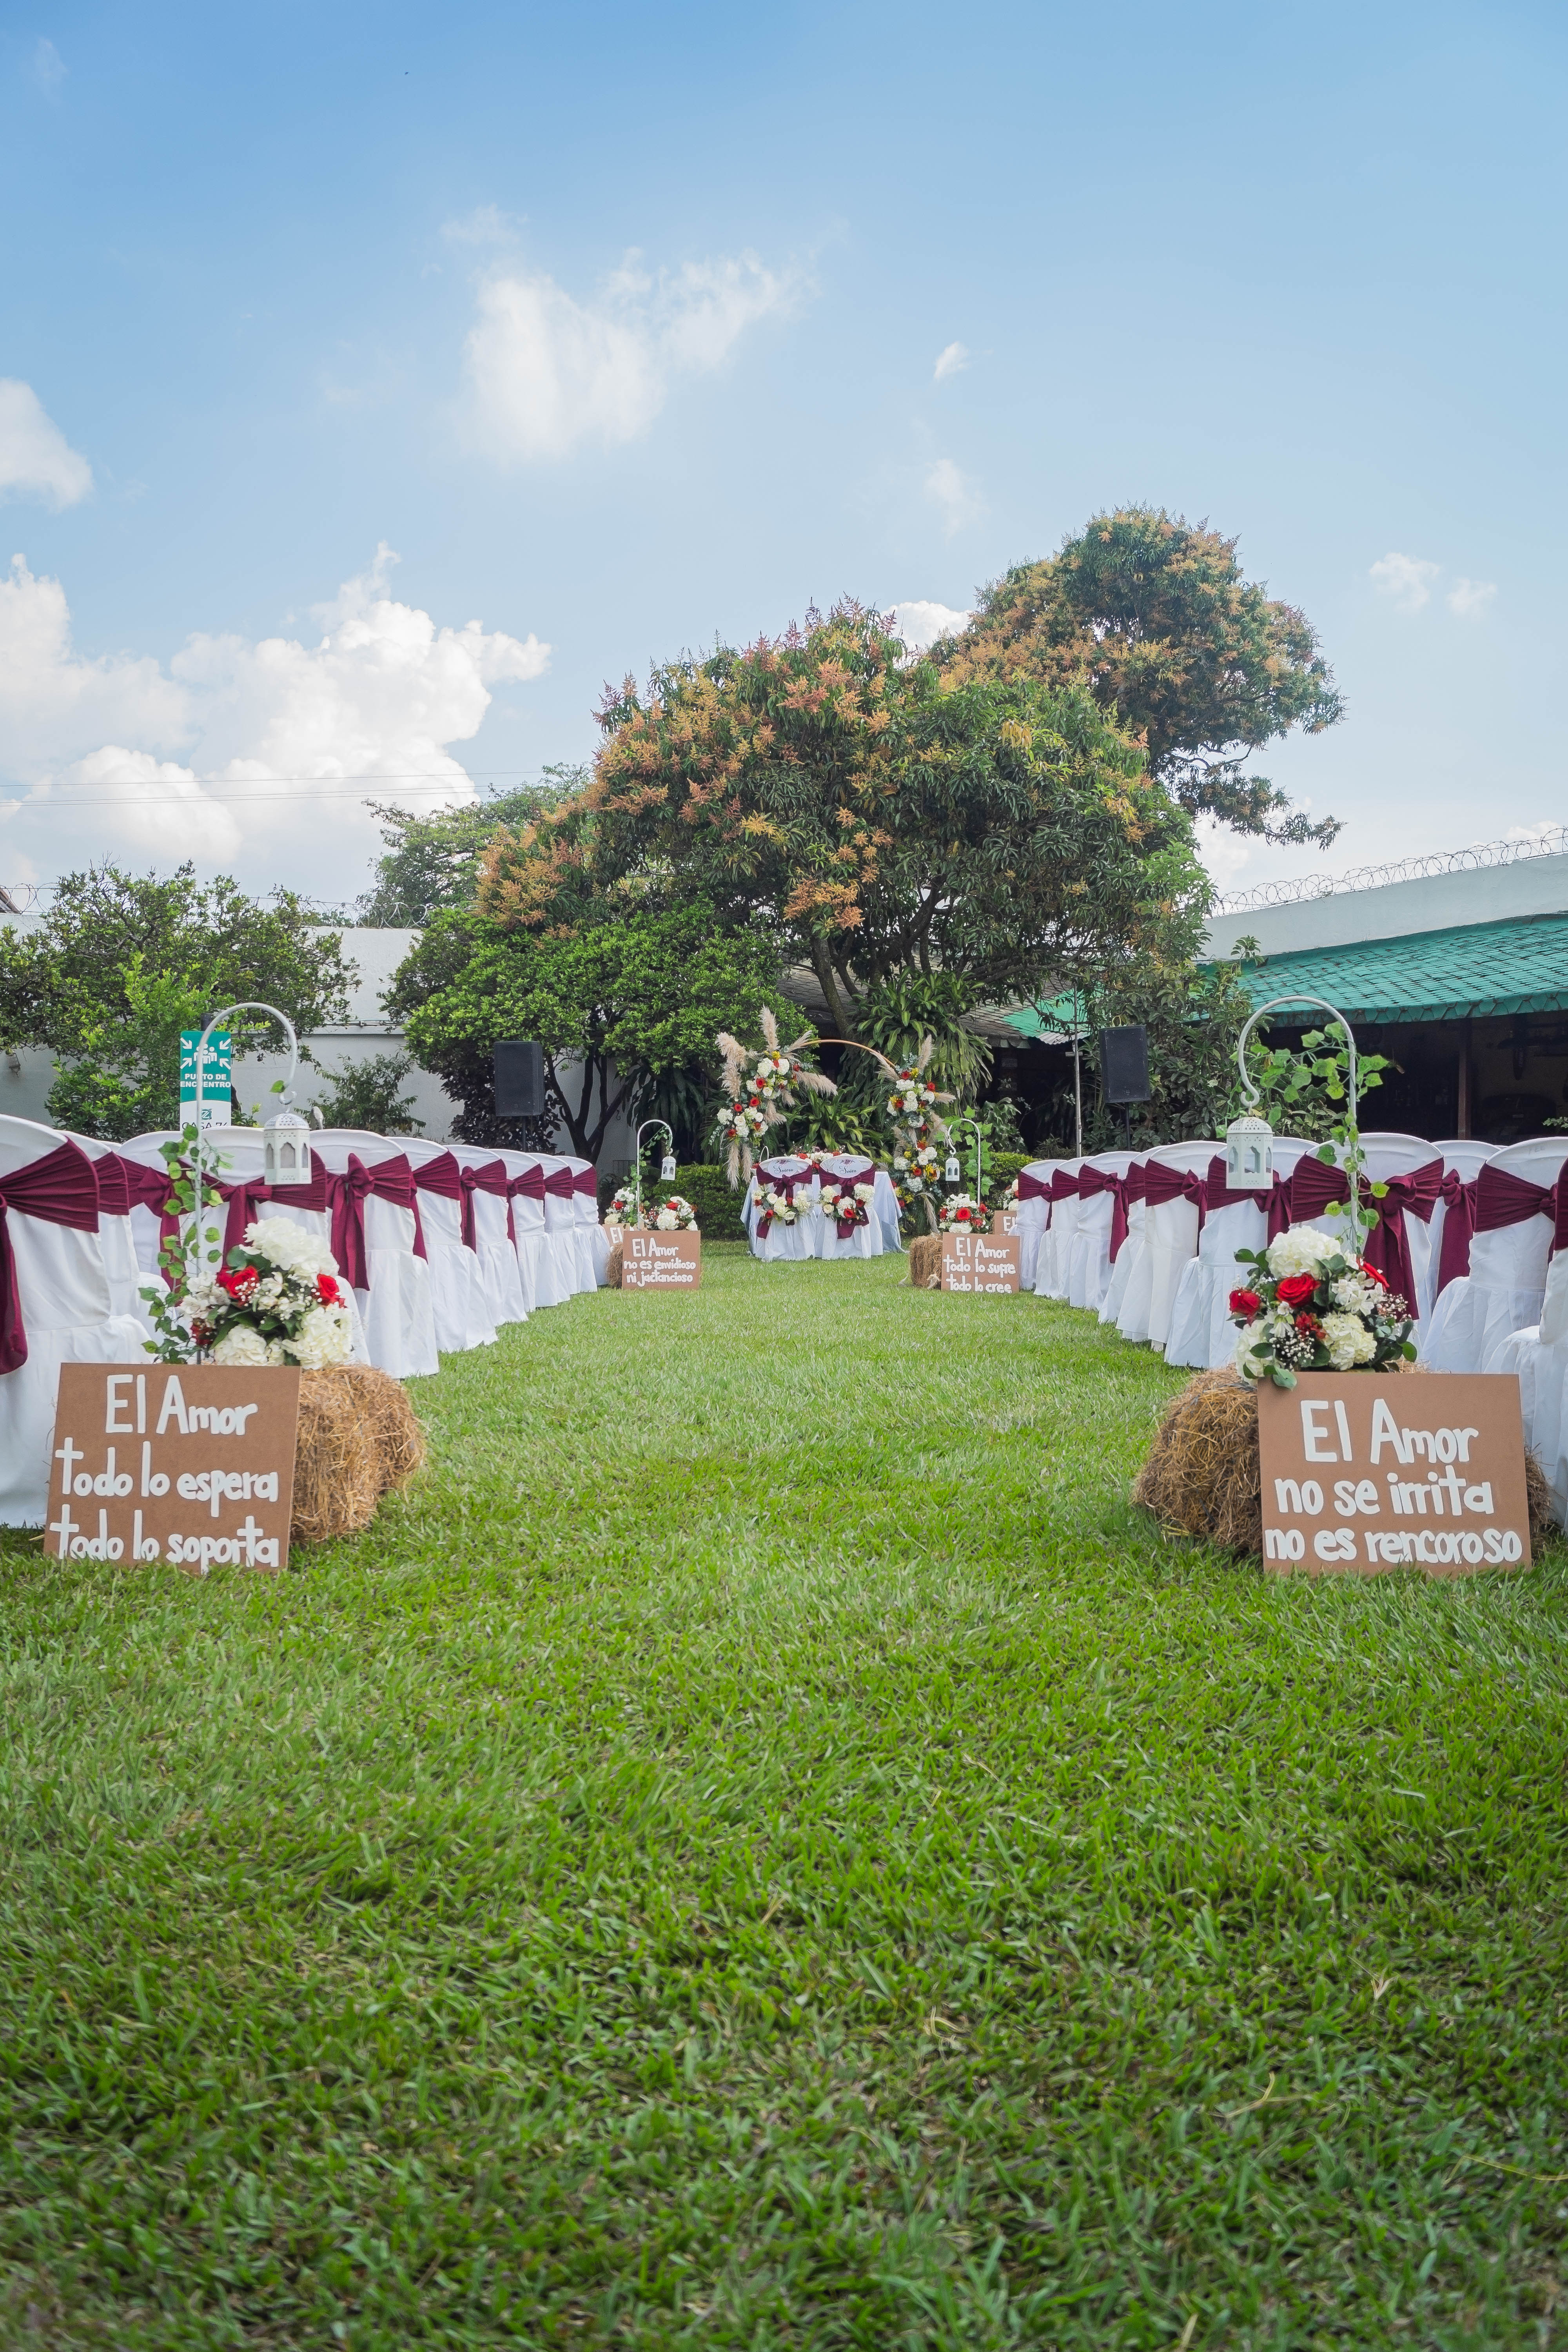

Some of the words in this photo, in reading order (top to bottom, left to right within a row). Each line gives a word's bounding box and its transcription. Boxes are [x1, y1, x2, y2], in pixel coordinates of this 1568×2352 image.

[773, 1165, 794, 1174] Señora
[839, 1165, 857, 1174] Señor
[1004, 1216, 1015, 1231] El
[610, 1227, 623, 1243] El
[632, 1238, 646, 1257] El
[648, 1238, 679, 1257] Amor
[956, 1237, 971, 1257] El
[975, 1239, 1010, 1258] Amor
[624, 1261, 638, 1269] no
[639, 1260, 652, 1270] es
[654, 1257, 696, 1270] envidioso
[943, 1254, 971, 1272] todo
[975, 1258, 985, 1272] lo
[626, 1272, 637, 1283] ni
[637, 1269, 693, 1287] jactancioso
[946, 1274, 972, 1291] todo
[975, 1276, 984, 1292] lo
[985, 1283, 1012, 1294] cree
[106, 1374, 146, 1434] El
[156, 1375, 258, 1436] Amor
[1301, 1399, 1352, 1463] El
[1370, 1398, 1479, 1465] Amor
[55, 1437, 133, 1497] todo
[141, 1441, 170, 1497] lo
[176, 1470, 279, 1517] espera
[1275, 1478, 1324, 1515] no
[1334, 1479, 1380, 1516] se
[1387, 1465, 1495, 1516] irrita
[49, 1504, 124, 1562] todo
[133, 1509, 160, 1562] lo
[166, 1515, 279, 1575] soporta
[1265, 1528, 1305, 1560] no
[1314, 1528, 1357, 1561] es
[1364, 1528, 1522, 1564] rencoroso
